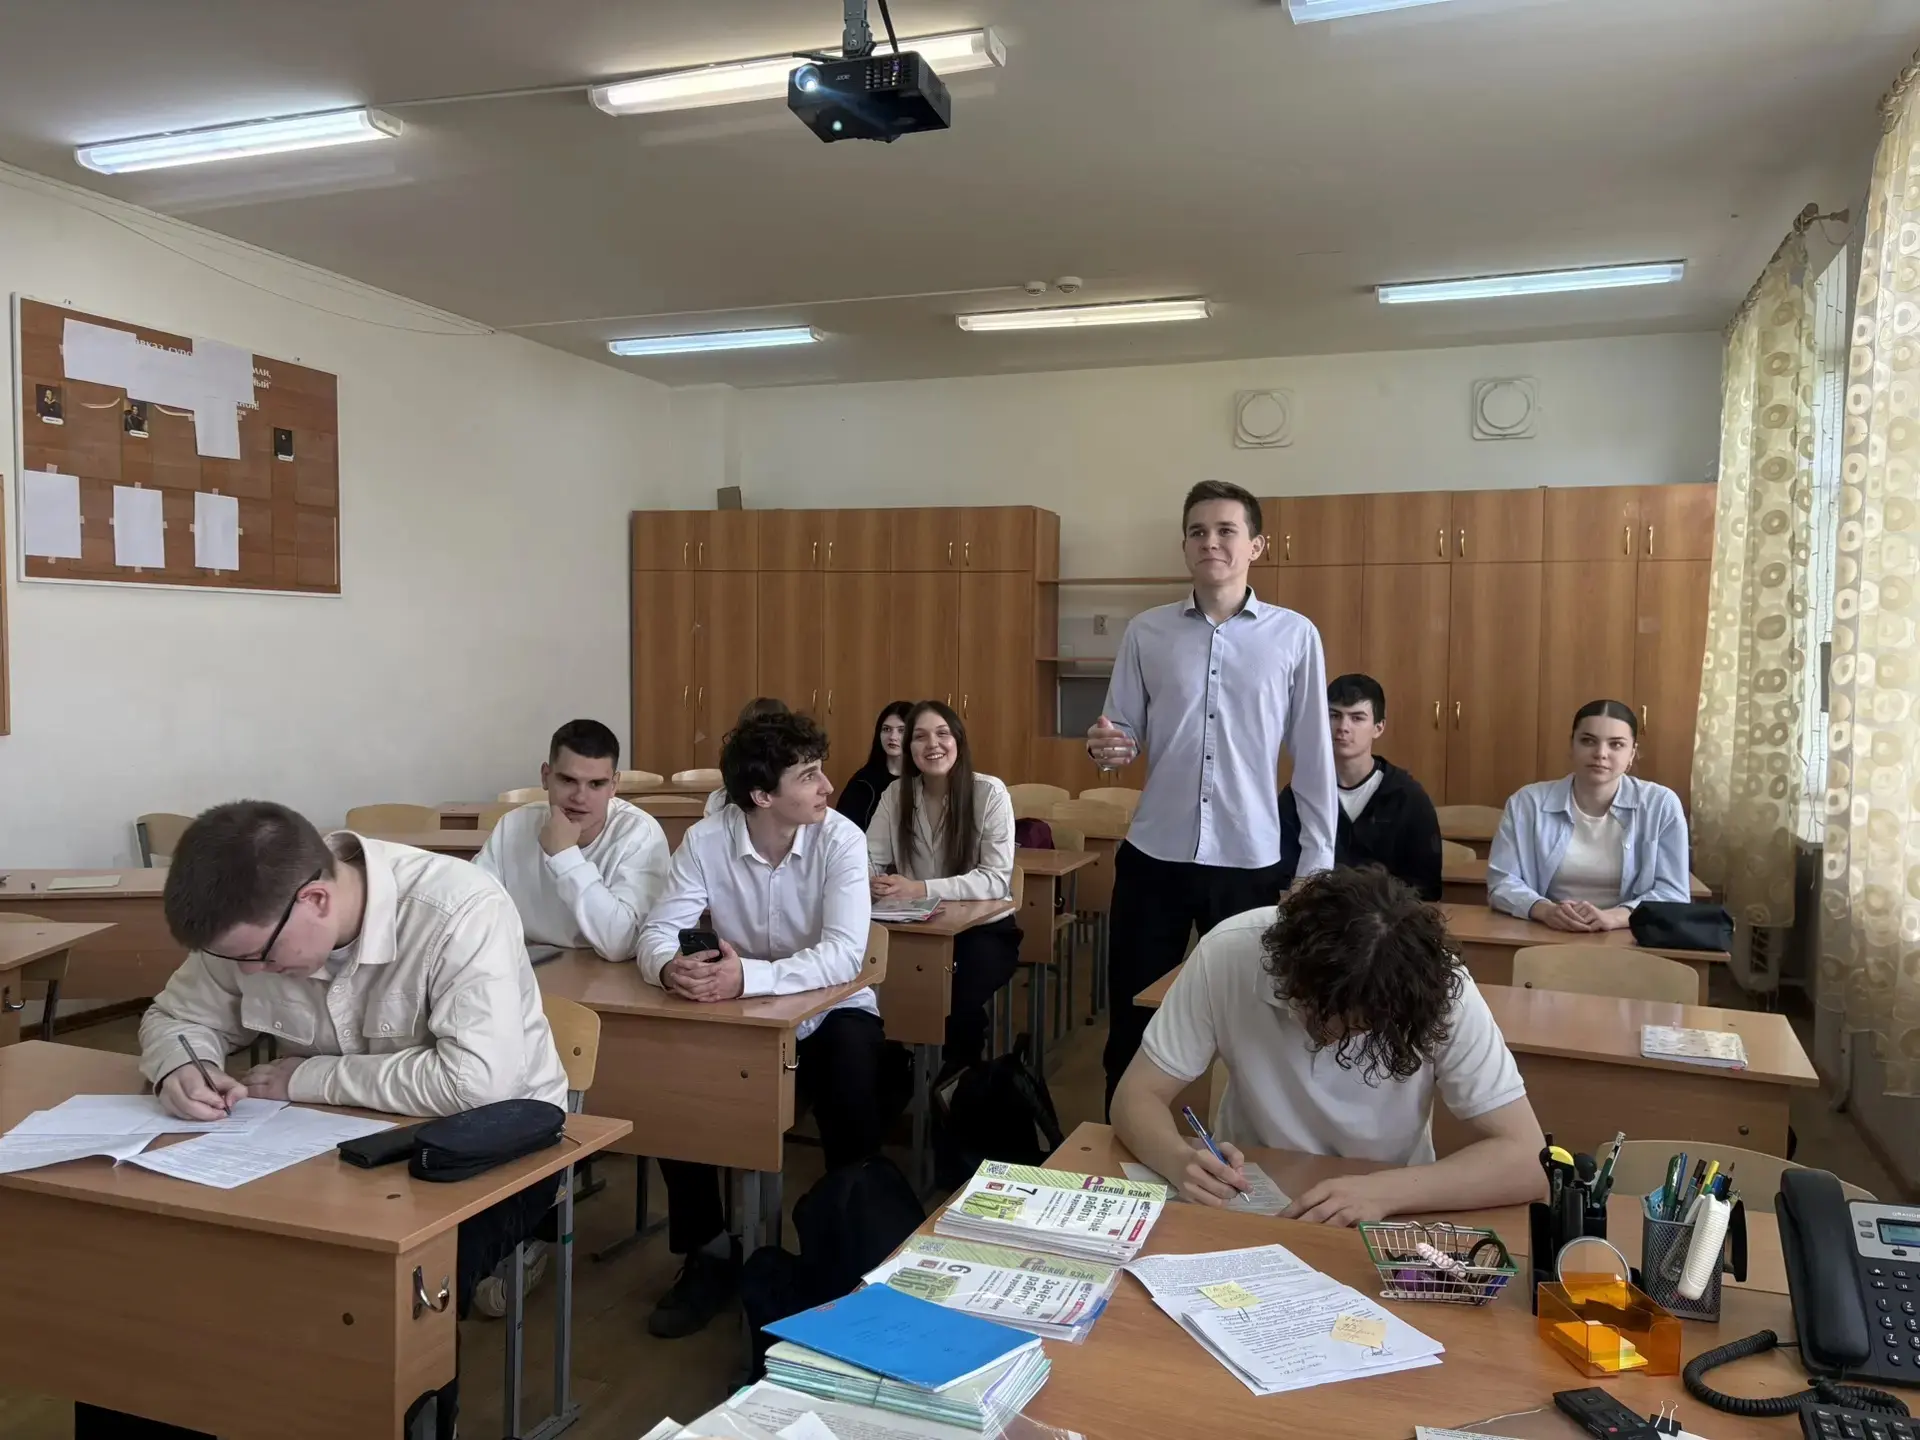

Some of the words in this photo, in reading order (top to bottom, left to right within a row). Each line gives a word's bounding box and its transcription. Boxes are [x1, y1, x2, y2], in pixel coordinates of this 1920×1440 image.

[1016, 1187, 1038, 1195] 7
[1082, 1176, 1125, 1195] Русский
[1127, 1189, 1152, 1198] язык
[1076, 1195, 1098, 1222] работы
[1088, 1198, 1117, 1232] Зачётные
[947, 1264, 972, 1274] 6
[1070, 1270, 1095, 1280] язык
